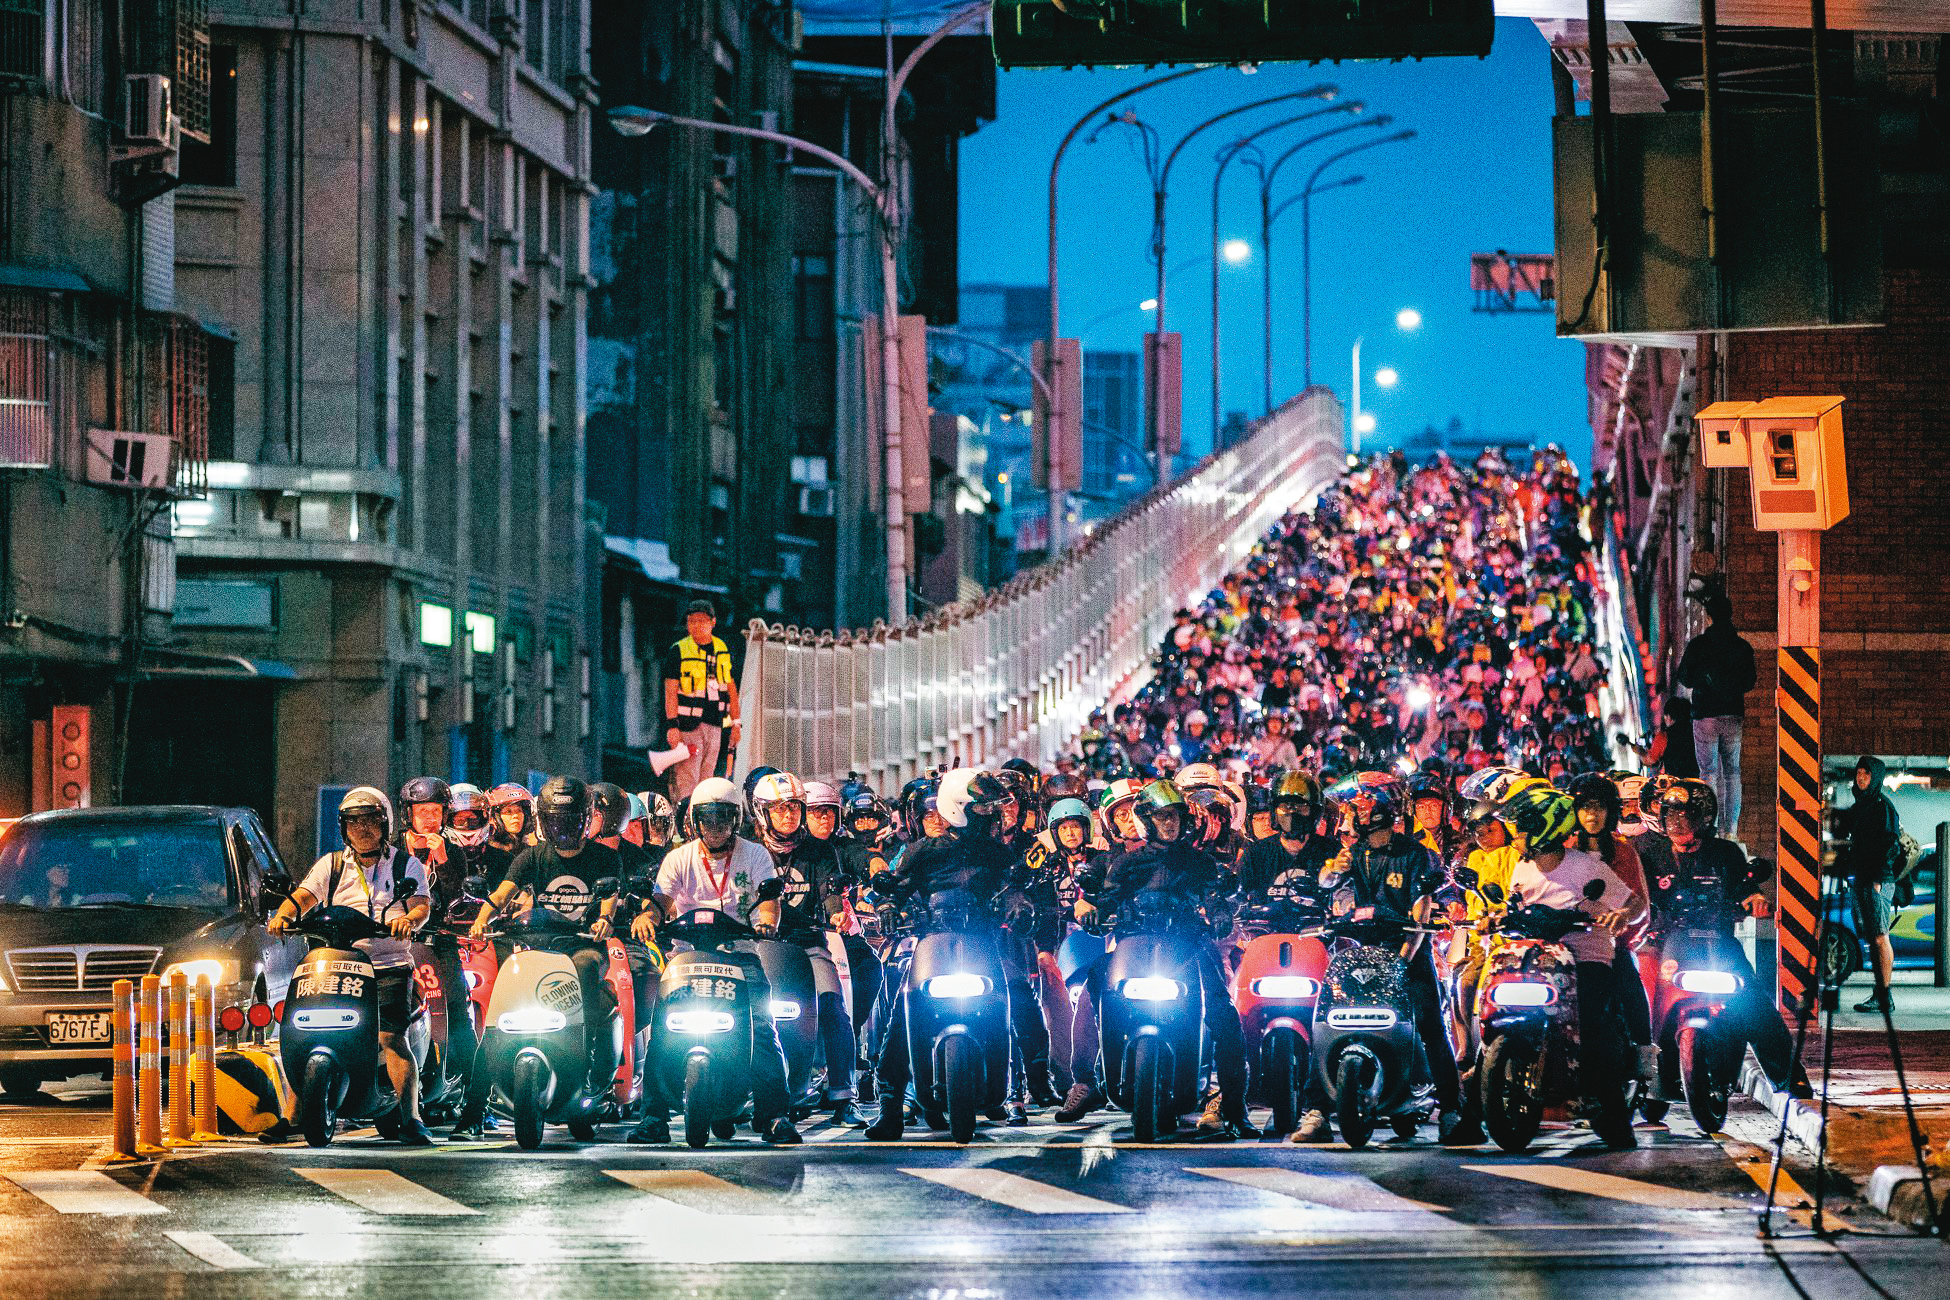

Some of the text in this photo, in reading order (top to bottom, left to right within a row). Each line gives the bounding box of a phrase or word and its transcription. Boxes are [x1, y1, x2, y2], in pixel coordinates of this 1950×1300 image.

[296, 975, 364, 999] 陳建銘
[425, 989, 442, 998] CING
[540, 980, 579, 1006] FLOWING
[554, 992, 583, 1011] OCEAN
